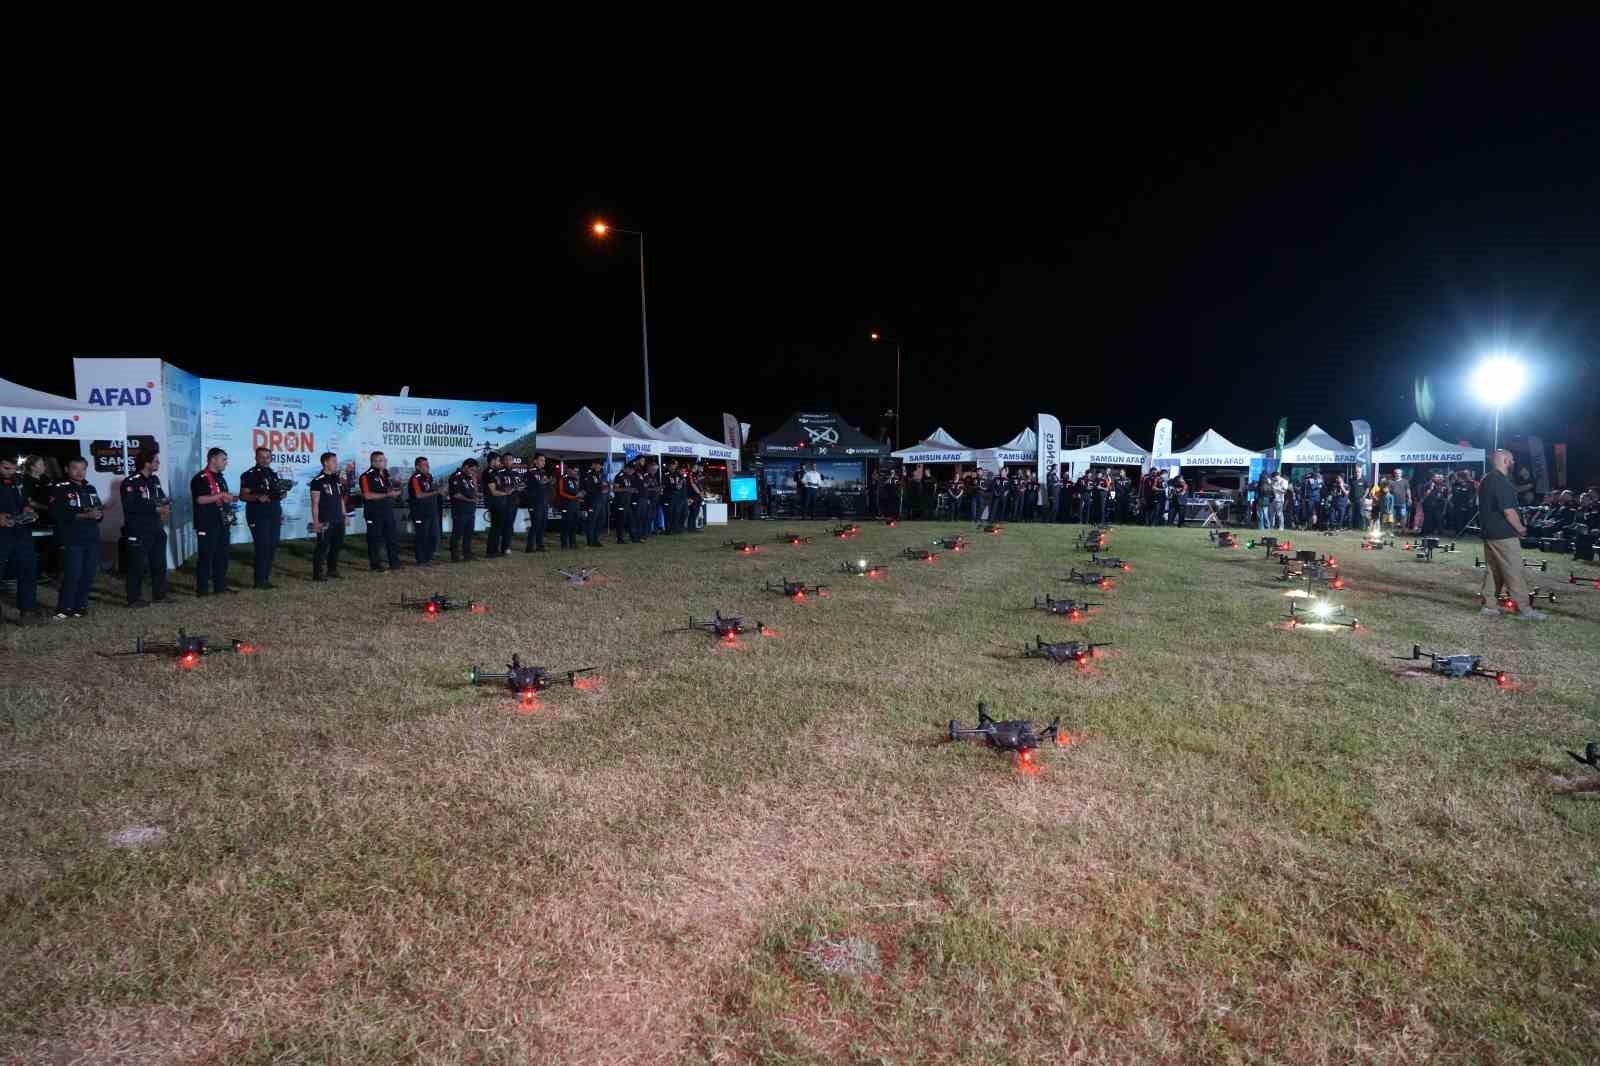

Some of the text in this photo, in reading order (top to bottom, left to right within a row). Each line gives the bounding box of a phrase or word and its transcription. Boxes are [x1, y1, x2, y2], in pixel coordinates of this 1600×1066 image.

[88, 387, 152, 406] AFAD
[426, 408, 449, 417] AFAD
[256, 409, 310, 430] AFAD
[22, 417, 76, 436] AFAD
[382, 421, 423, 433] GÖKTEKİ
[252, 429, 315, 453] DRON
[382, 433, 421, 446] YERDEKİ
[909, 453, 961, 462] SAMSUN AFAD
[998, 453, 1032, 461] SAMSUN
[1090, 455, 1146, 464] SAMSUN AFAD
[1186, 457, 1244, 465] SAMSUN AFAD
[1334, 455, 1357, 463] AFAD
[1400, 453, 1462, 462] SAMSUN AFAD
